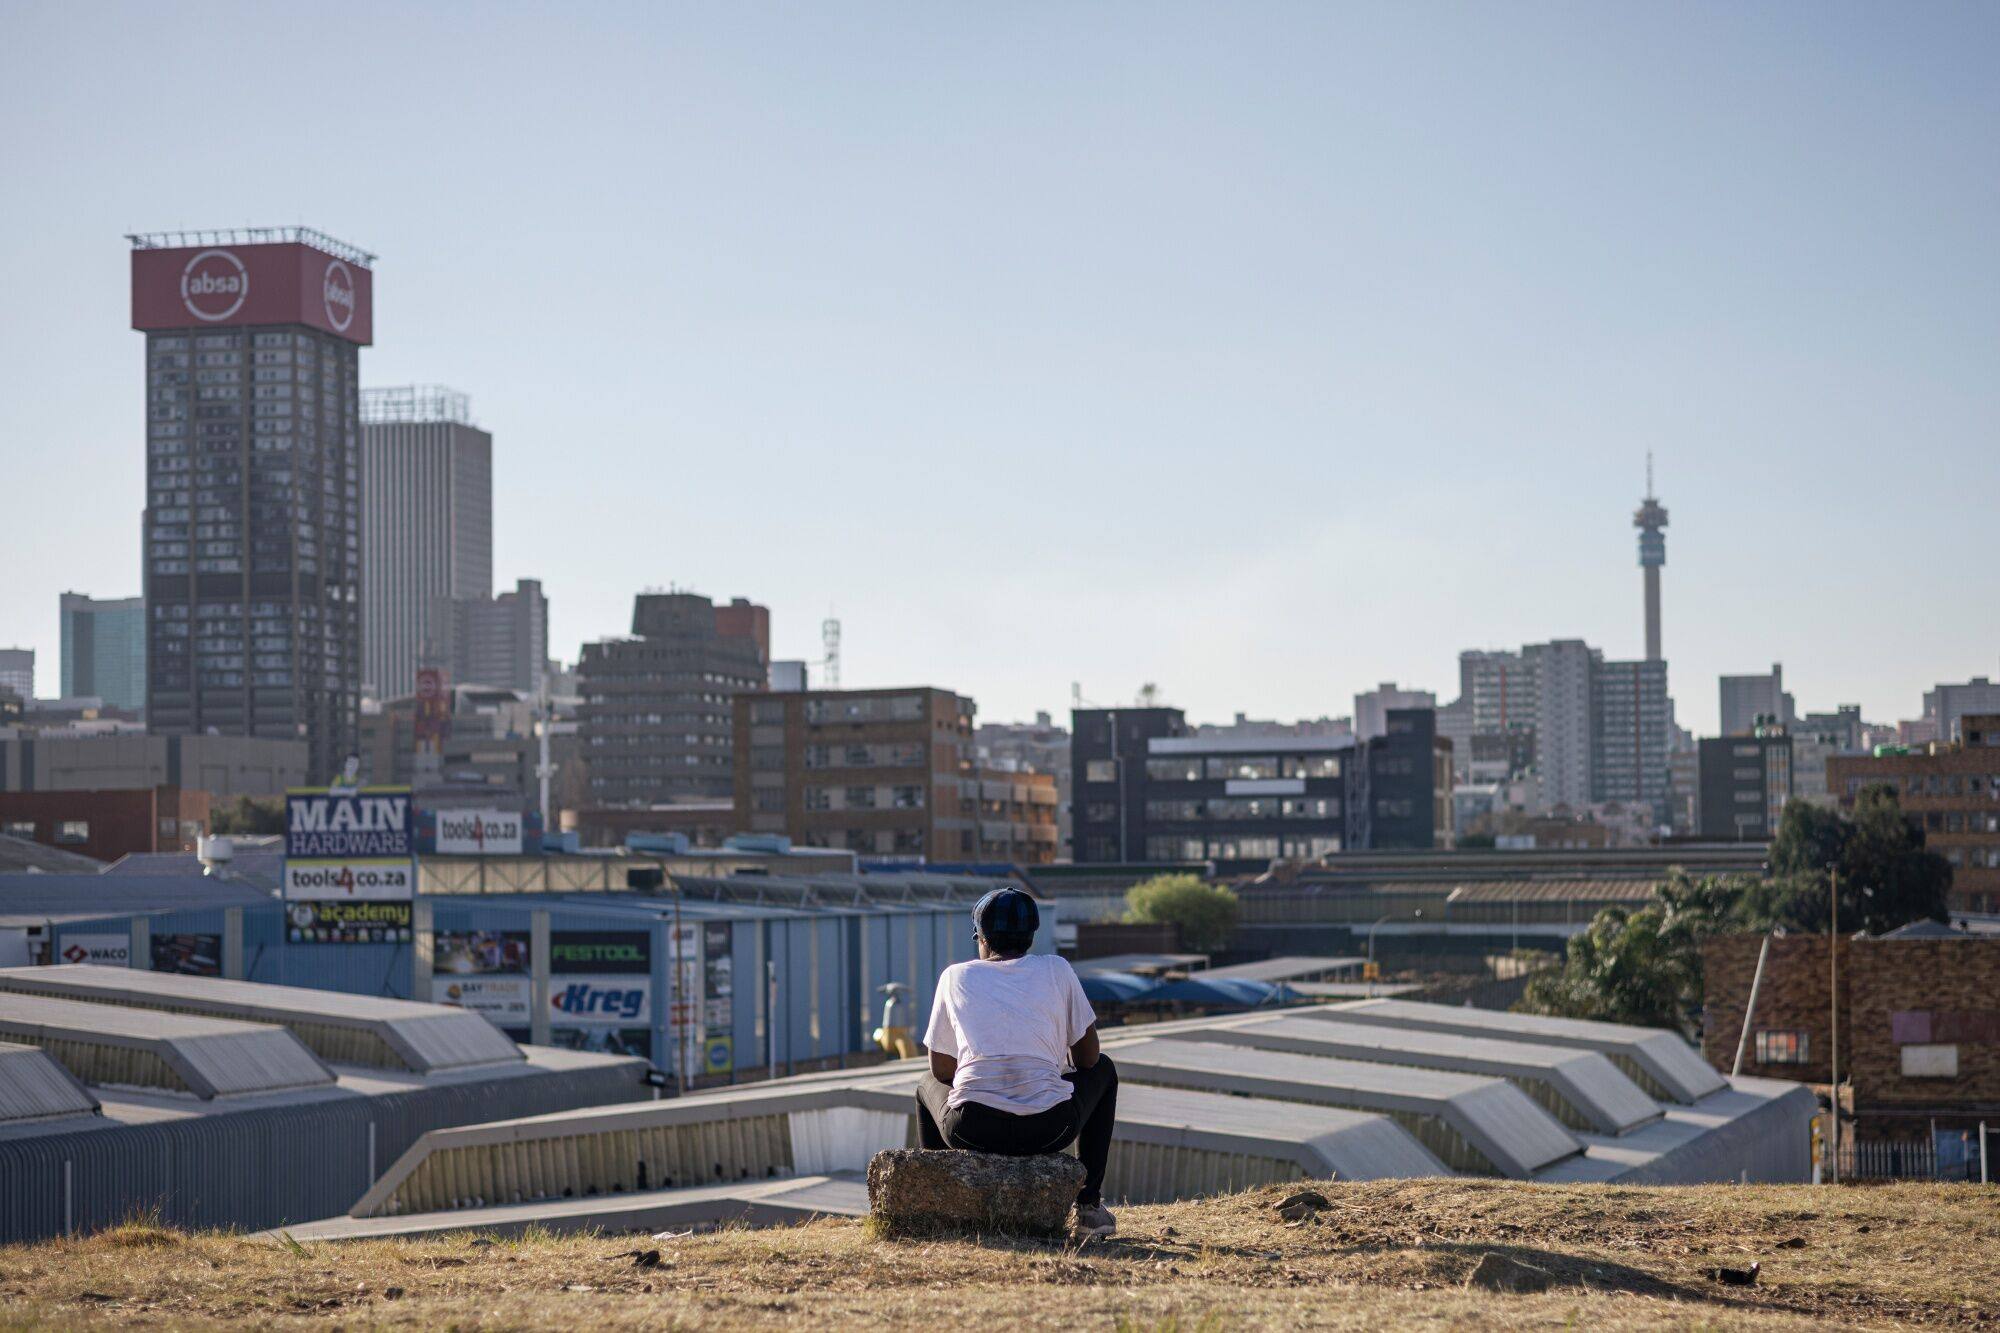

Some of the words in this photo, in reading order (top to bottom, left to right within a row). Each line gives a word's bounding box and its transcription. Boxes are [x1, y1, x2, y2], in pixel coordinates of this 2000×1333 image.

[190, 270, 240, 294] absa
[290, 798, 406, 832] MAIN
[292, 833, 408, 854] HARDWARE
[292, 866, 406, 894] tools4co.za
[320, 903, 410, 924] academy
[91, 949, 127, 959] WACO
[553, 944, 647, 961] FESTOOL
[563, 984, 644, 1018] Kreg
